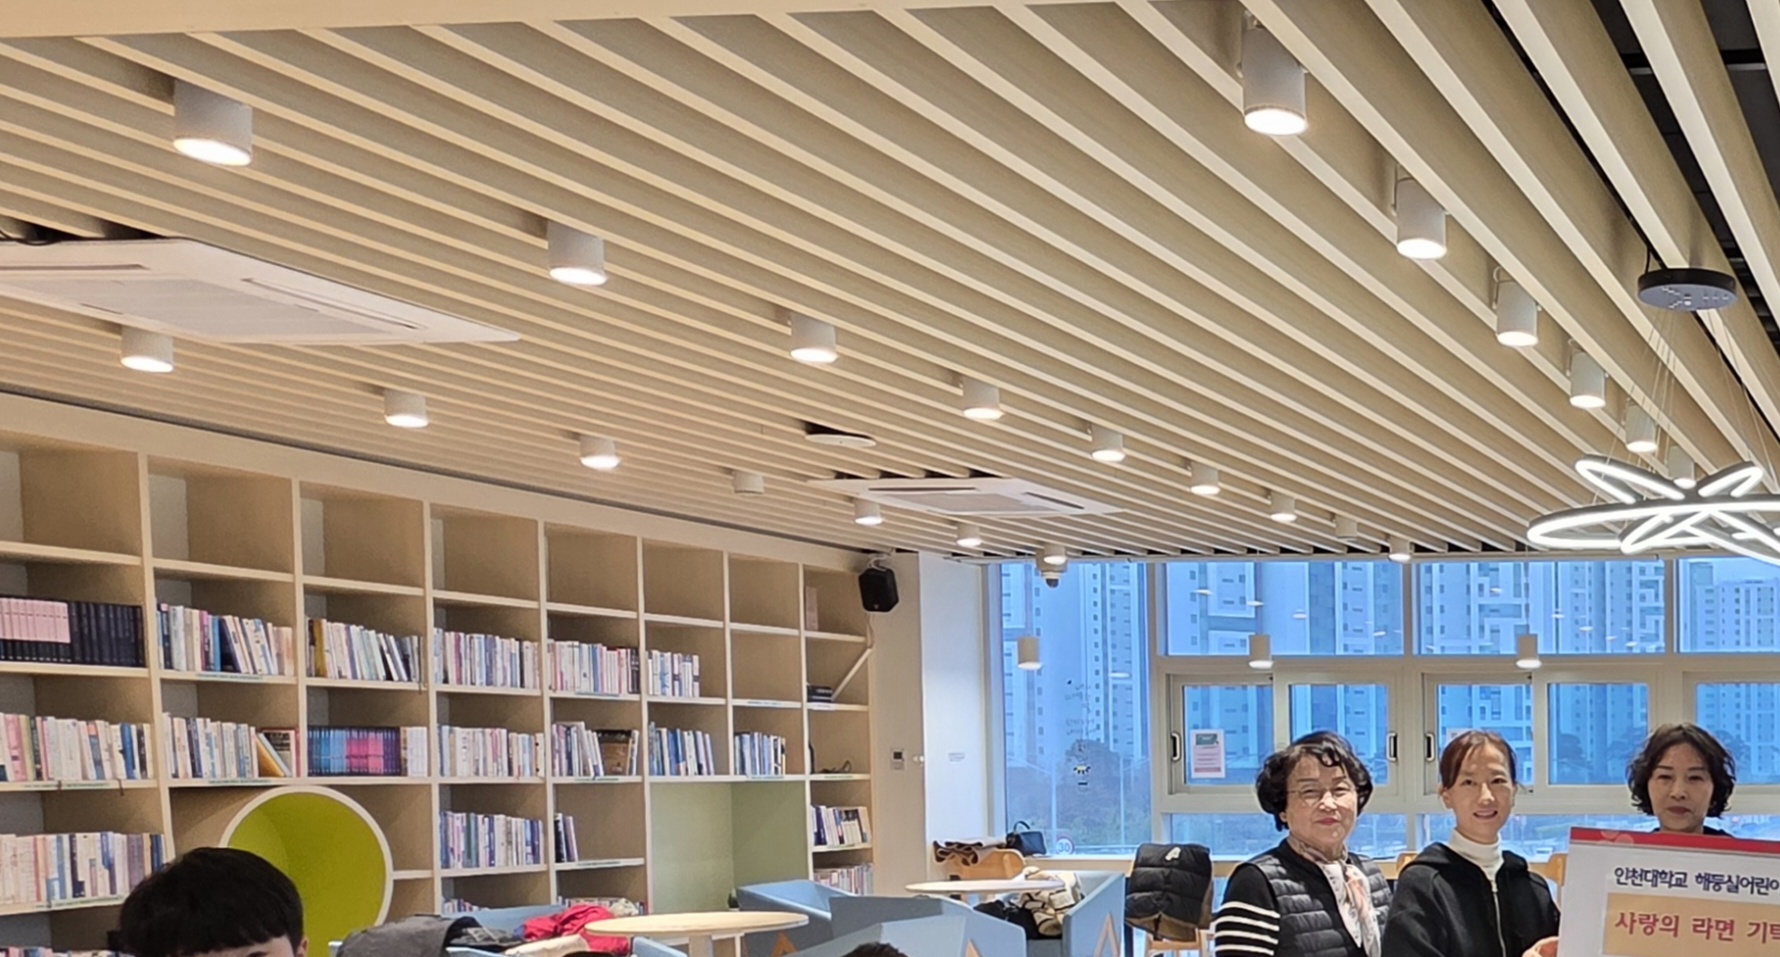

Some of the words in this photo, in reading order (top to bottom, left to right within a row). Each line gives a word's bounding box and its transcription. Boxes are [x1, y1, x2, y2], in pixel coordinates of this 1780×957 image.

[1614, 867, 1688, 889] 인천대학교
[1615, 911, 1680, 938] 사랑의
[1692, 917, 1736, 942] 라면
